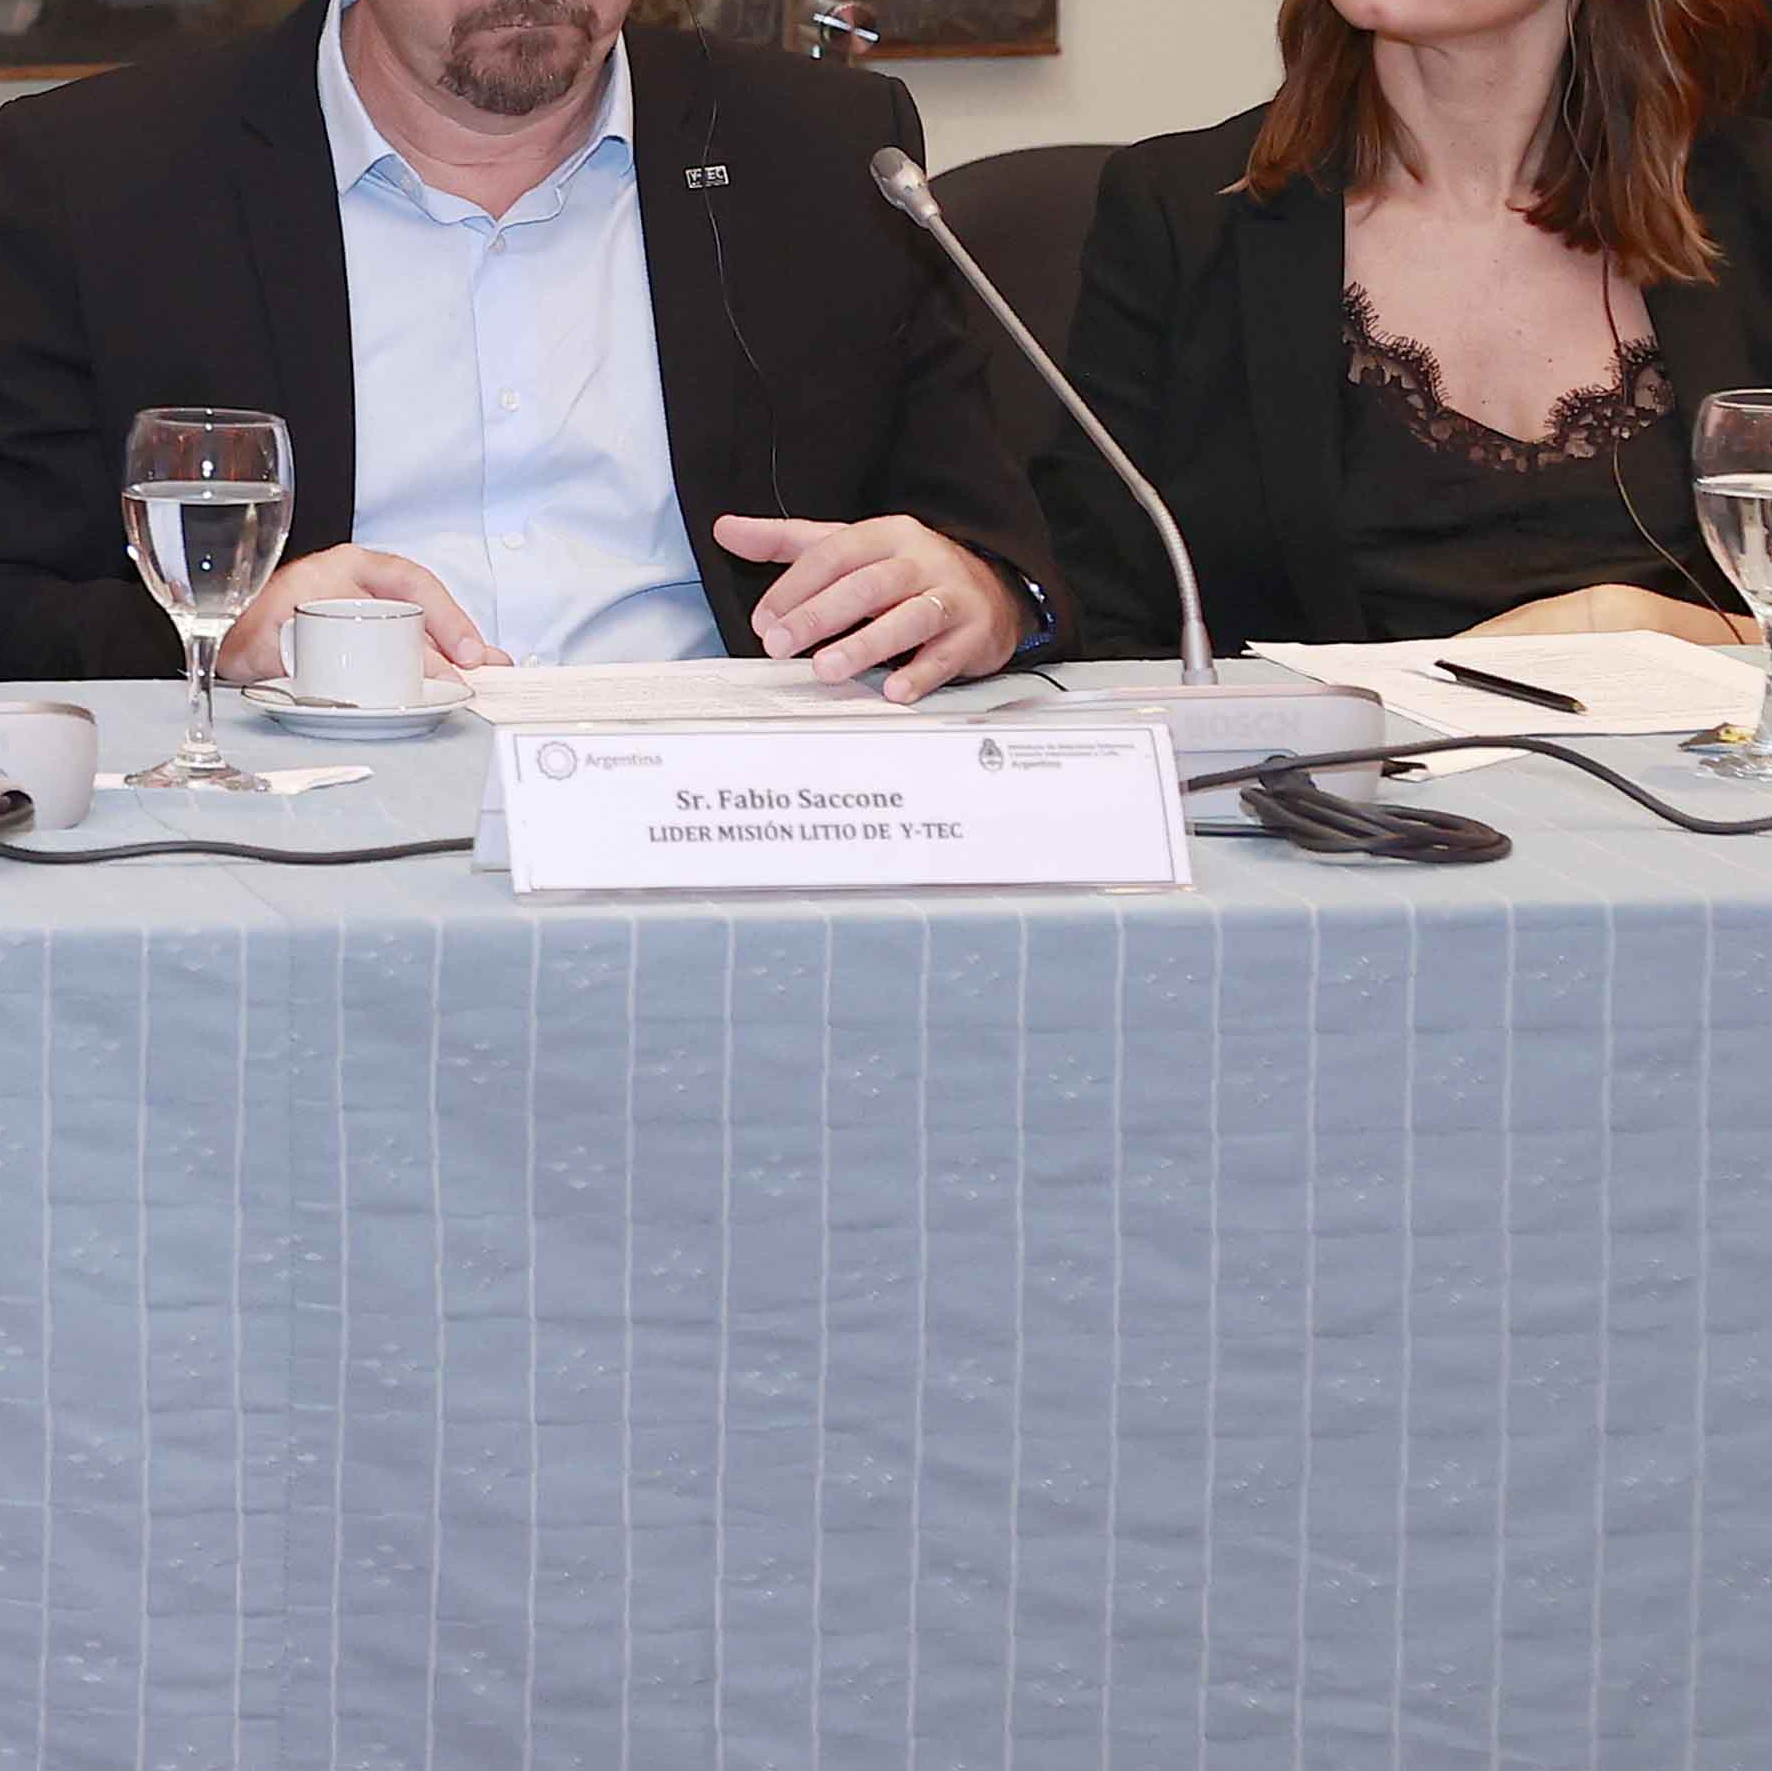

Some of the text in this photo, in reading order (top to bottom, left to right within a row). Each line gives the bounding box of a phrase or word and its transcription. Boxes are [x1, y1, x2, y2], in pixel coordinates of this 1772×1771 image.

[584, 753, 664, 771] Argentina
[676, 787, 903, 811] Sr. Fabio Saccone
[648, 821, 963, 843] LIDER MISIÓN LITIO DE Y-TEC
